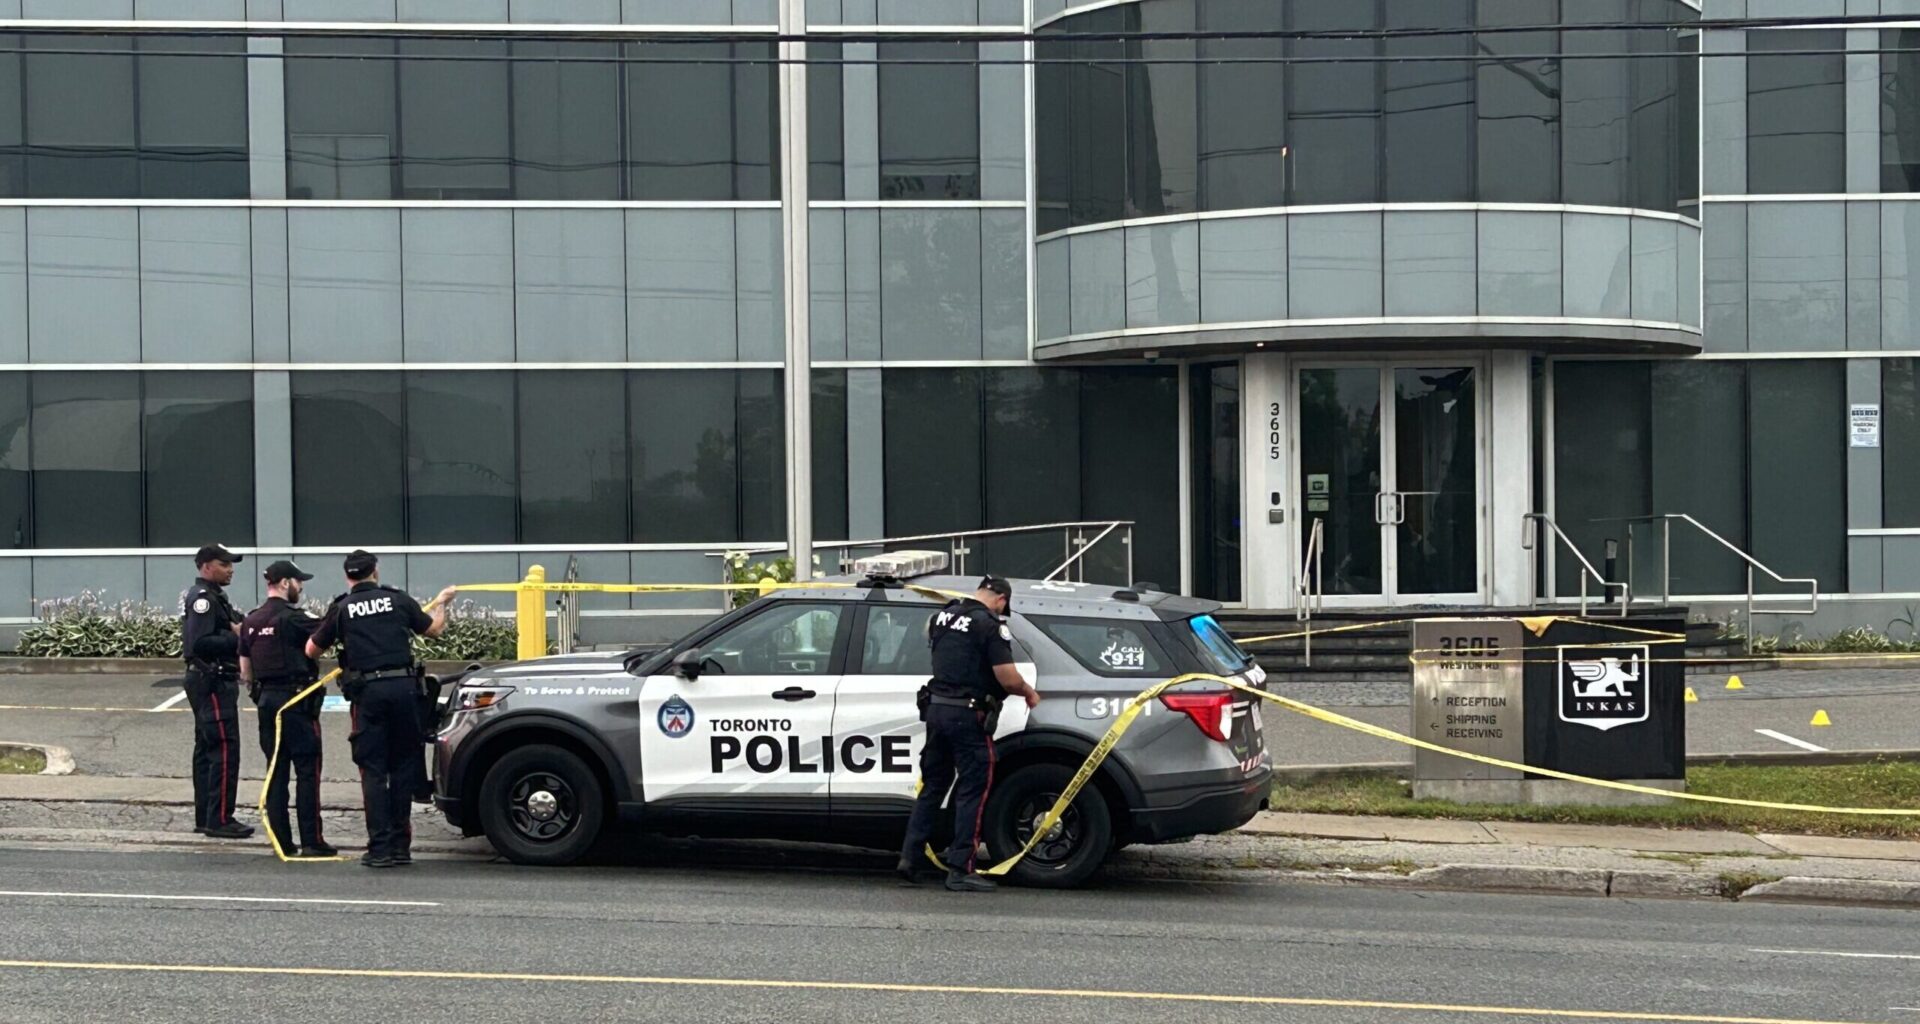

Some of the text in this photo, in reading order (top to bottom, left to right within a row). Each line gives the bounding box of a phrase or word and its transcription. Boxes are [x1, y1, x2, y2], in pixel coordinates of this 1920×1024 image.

[1270, 402, 1280, 460] 3605
[347, 596, 393, 619] POLICE
[1440, 636, 1500, 657] 3605
[1111, 651, 1145, 666] 9-1-1
[1440, 661, 1483, 670] WESTON
[524, 686, 631, 695] To Serve & Protect
[1446, 696, 1507, 707] RECEPTION
[1576, 701, 1636, 711] INKAS
[709, 718, 792, 732] TORONTO
[1446, 714, 1497, 725] SHIPPING
[1446, 728, 1504, 738] RECEIVING
[710, 735, 913, 773] POLICE
